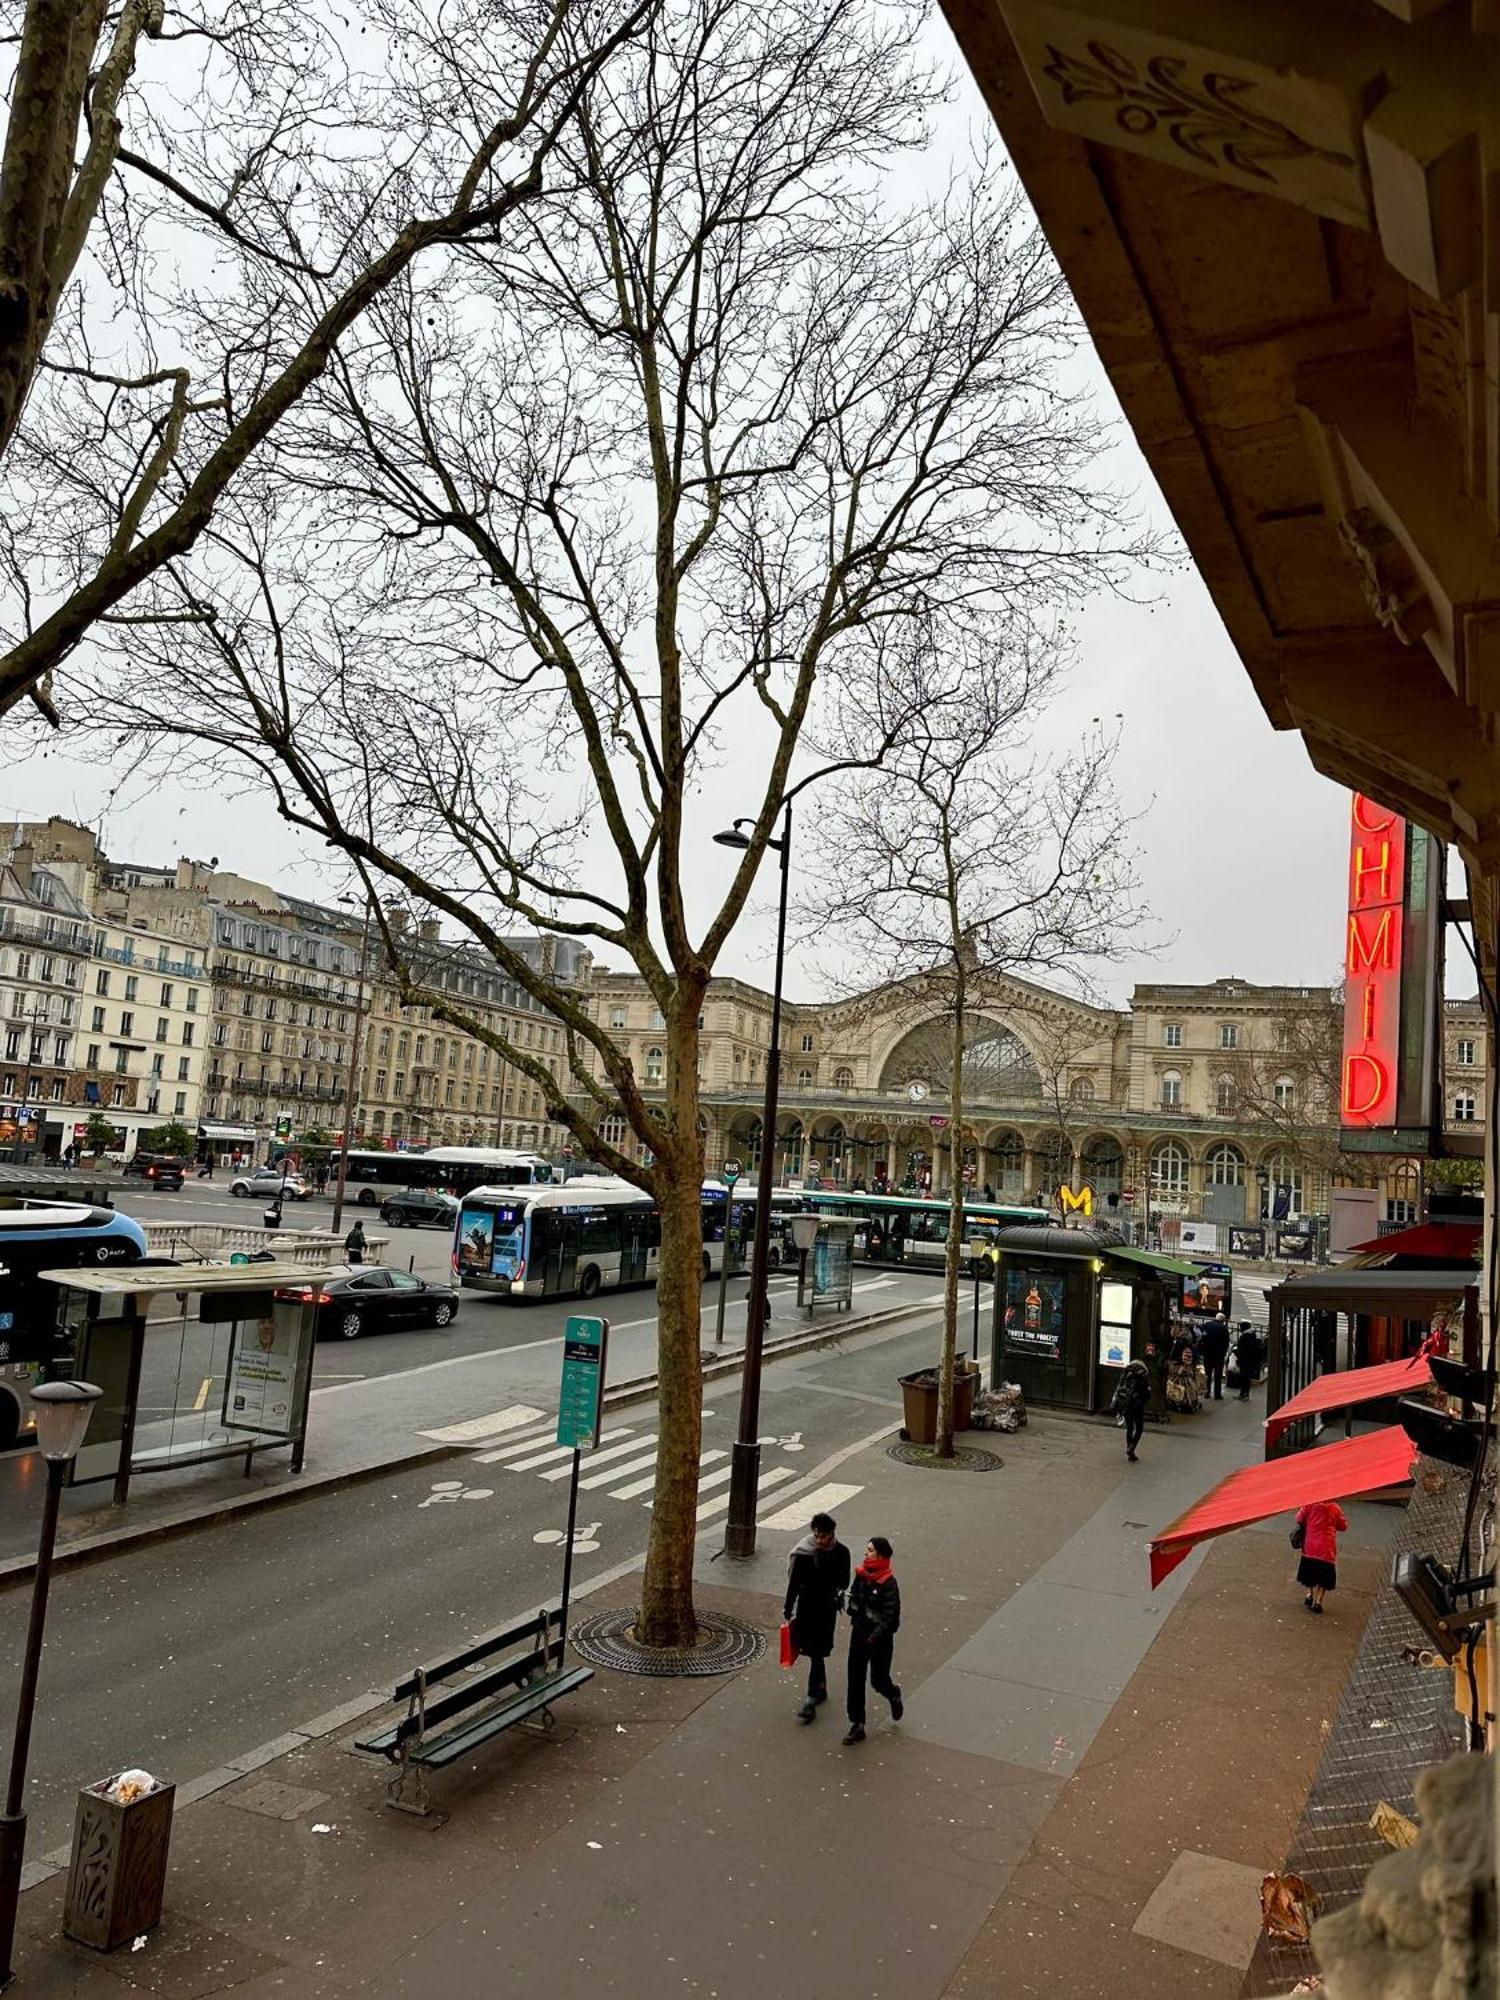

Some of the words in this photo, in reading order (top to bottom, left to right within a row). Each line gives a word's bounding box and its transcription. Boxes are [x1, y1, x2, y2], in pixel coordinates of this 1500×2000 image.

[1060, 1184, 1092, 1217] M
[502, 1211, 513, 1221] 38
[1037, 1333, 1059, 1342] PROCESS
